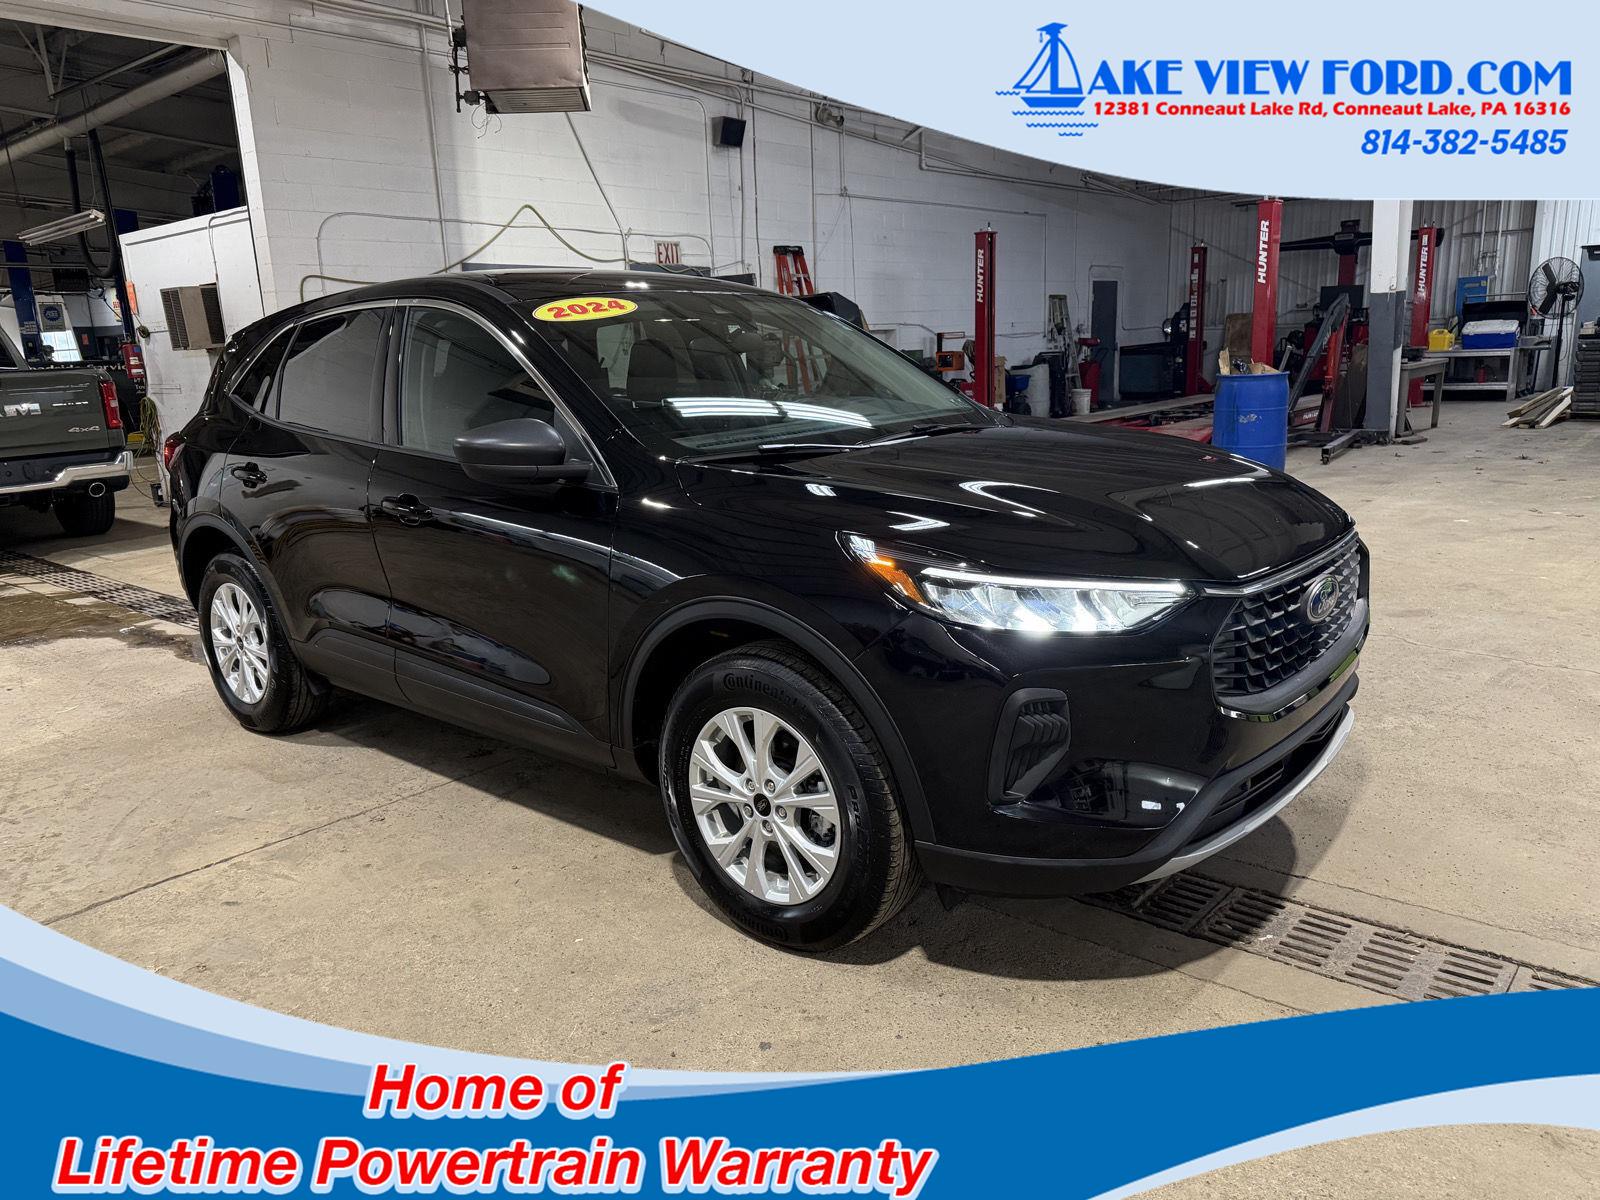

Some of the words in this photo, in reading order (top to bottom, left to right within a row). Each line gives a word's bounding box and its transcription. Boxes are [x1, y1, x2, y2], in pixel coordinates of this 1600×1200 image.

[656, 242, 680, 264] EXIT
[1257, 219, 1270, 284] HUNTER
[1417, 246, 1428, 293] HUNTER
[976, 248, 984, 303] HUNTER
[547, 299, 628, 319] 2024
